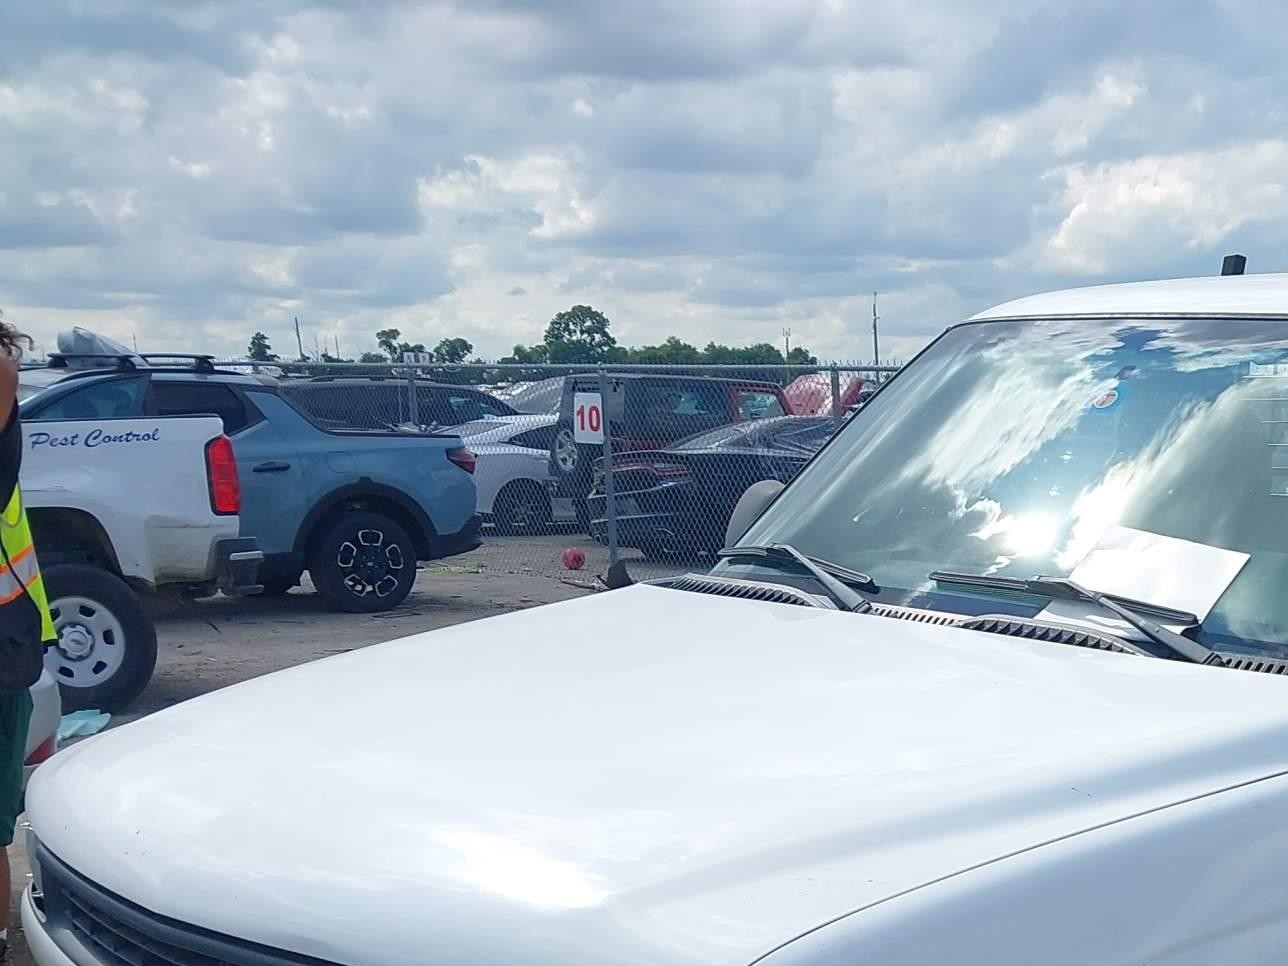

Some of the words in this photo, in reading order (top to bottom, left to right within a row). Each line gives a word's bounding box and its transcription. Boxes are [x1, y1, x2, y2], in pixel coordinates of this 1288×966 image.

[576, 404, 601, 432] 10
[29, 432, 79, 450] Pest
[84, 428, 160, 448] Control
